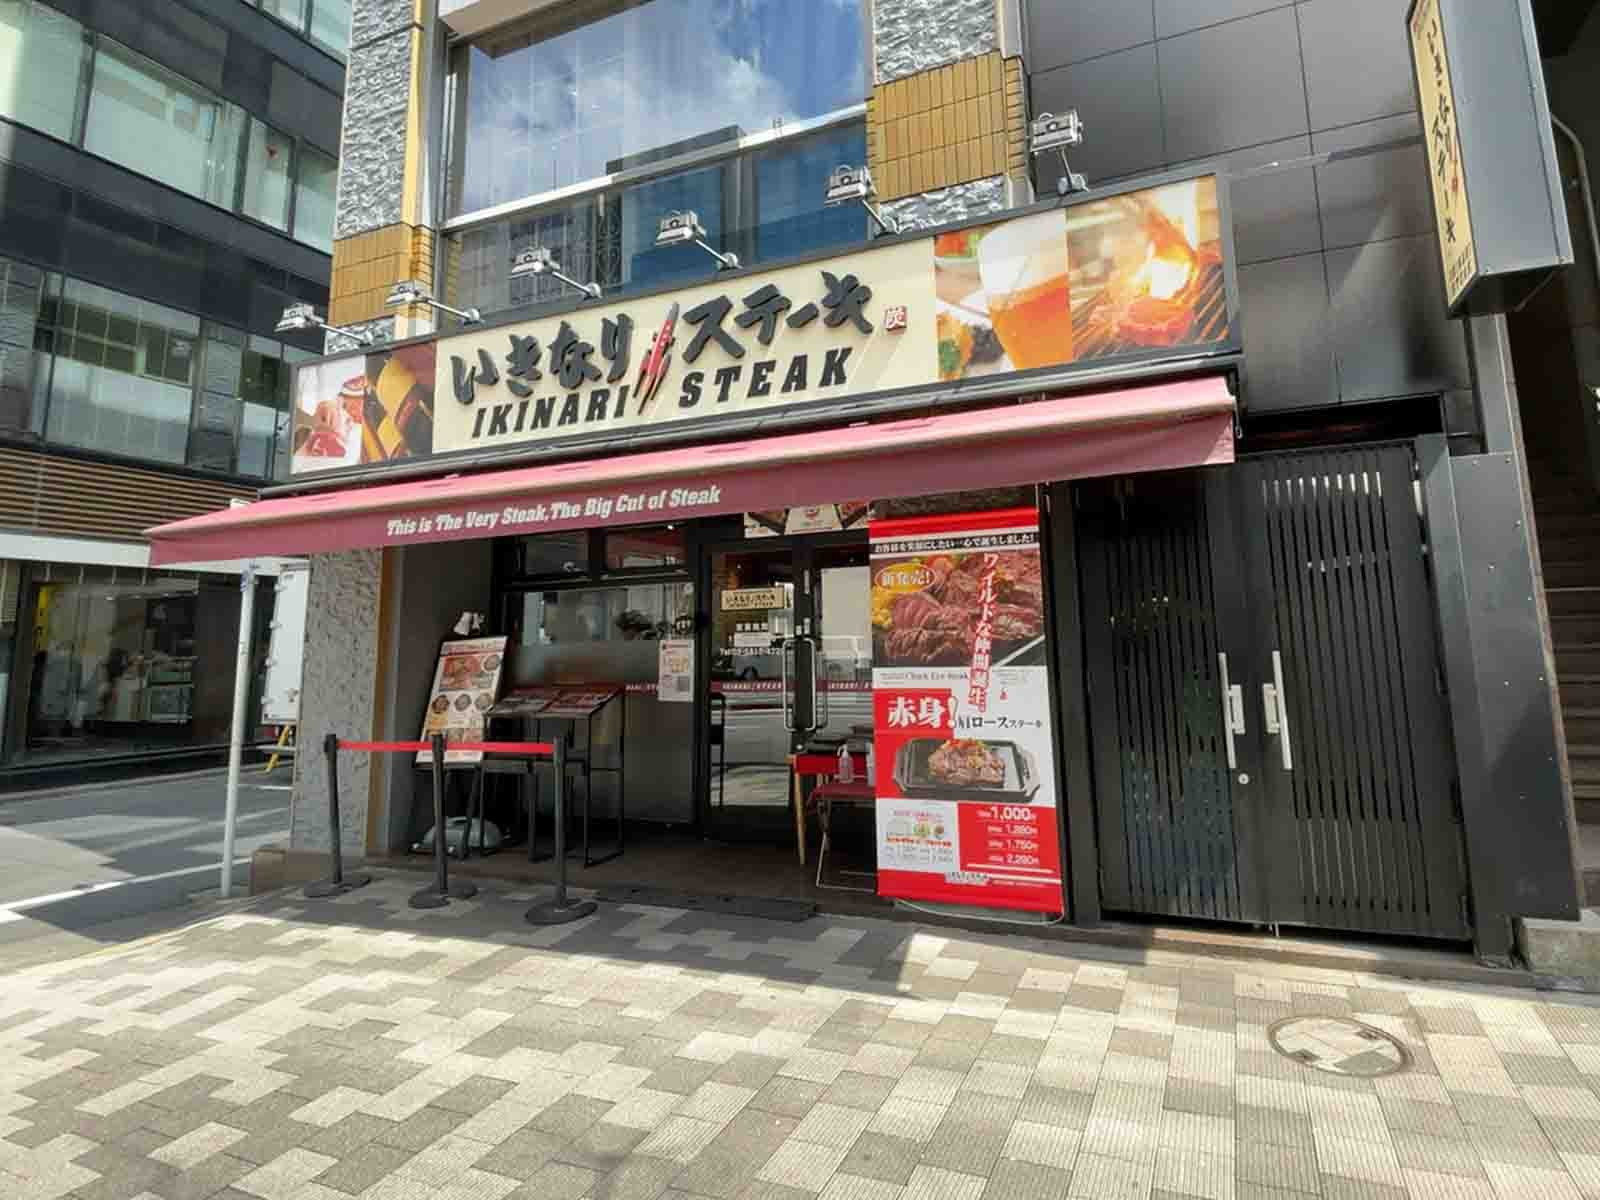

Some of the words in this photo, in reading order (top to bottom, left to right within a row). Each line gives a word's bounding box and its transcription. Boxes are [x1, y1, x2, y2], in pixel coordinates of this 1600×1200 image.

[451, 313, 633, 405] いきなり
[682, 271, 874, 364] ステーキ
[472, 386, 630, 438] IKINARI
[678, 348, 853, 408] STEAK
[387, 519, 416, 536] This
[418, 518, 432, 533] is
[435, 514, 463, 531] The
[465, 511, 498, 528] Very
[551, 501, 581, 520] The
[584, 497, 613, 519] Big
[616, 494, 645, 513] Cut
[648, 490, 668, 509] of
[669, 485, 721, 507] Steak
